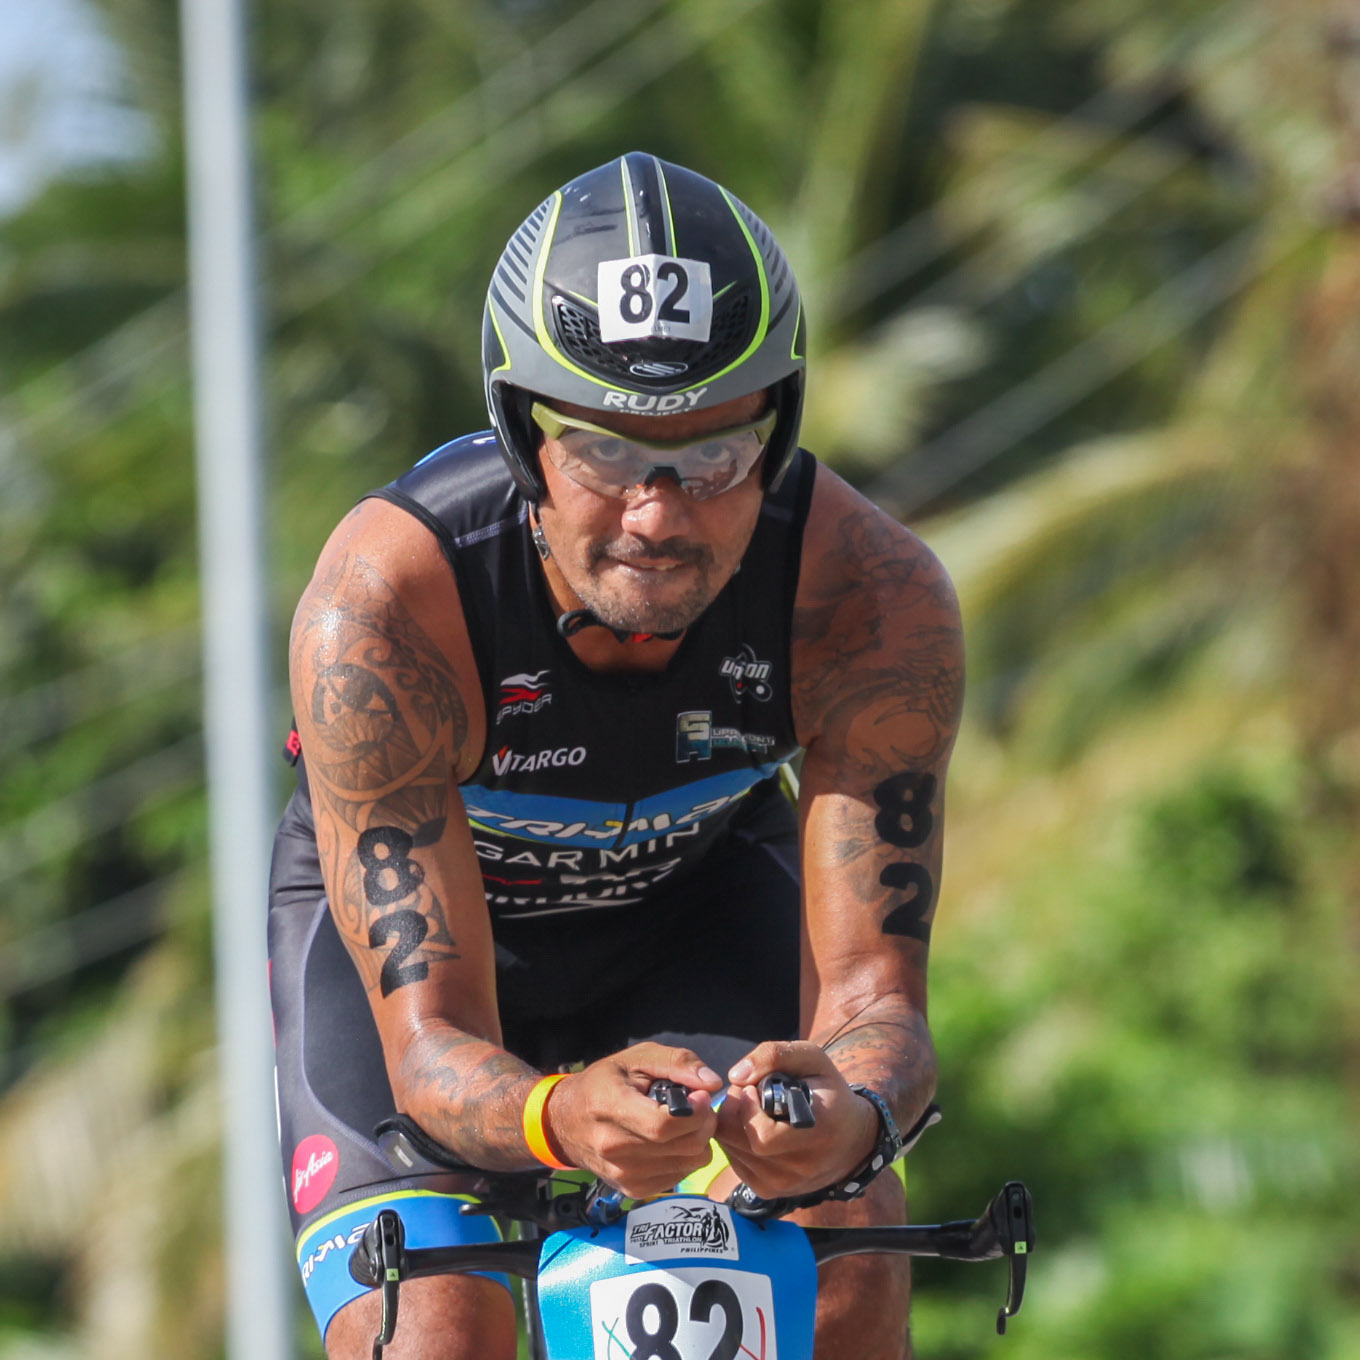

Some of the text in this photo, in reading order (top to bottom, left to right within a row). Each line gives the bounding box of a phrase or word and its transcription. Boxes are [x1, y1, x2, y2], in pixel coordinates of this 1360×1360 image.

[619, 261, 690, 325] 82
[603, 387, 708, 411] RUDY
[496, 693, 552, 725] SPYDER
[873, 772, 938, 943] 82
[356, 826, 430, 1000] 82
